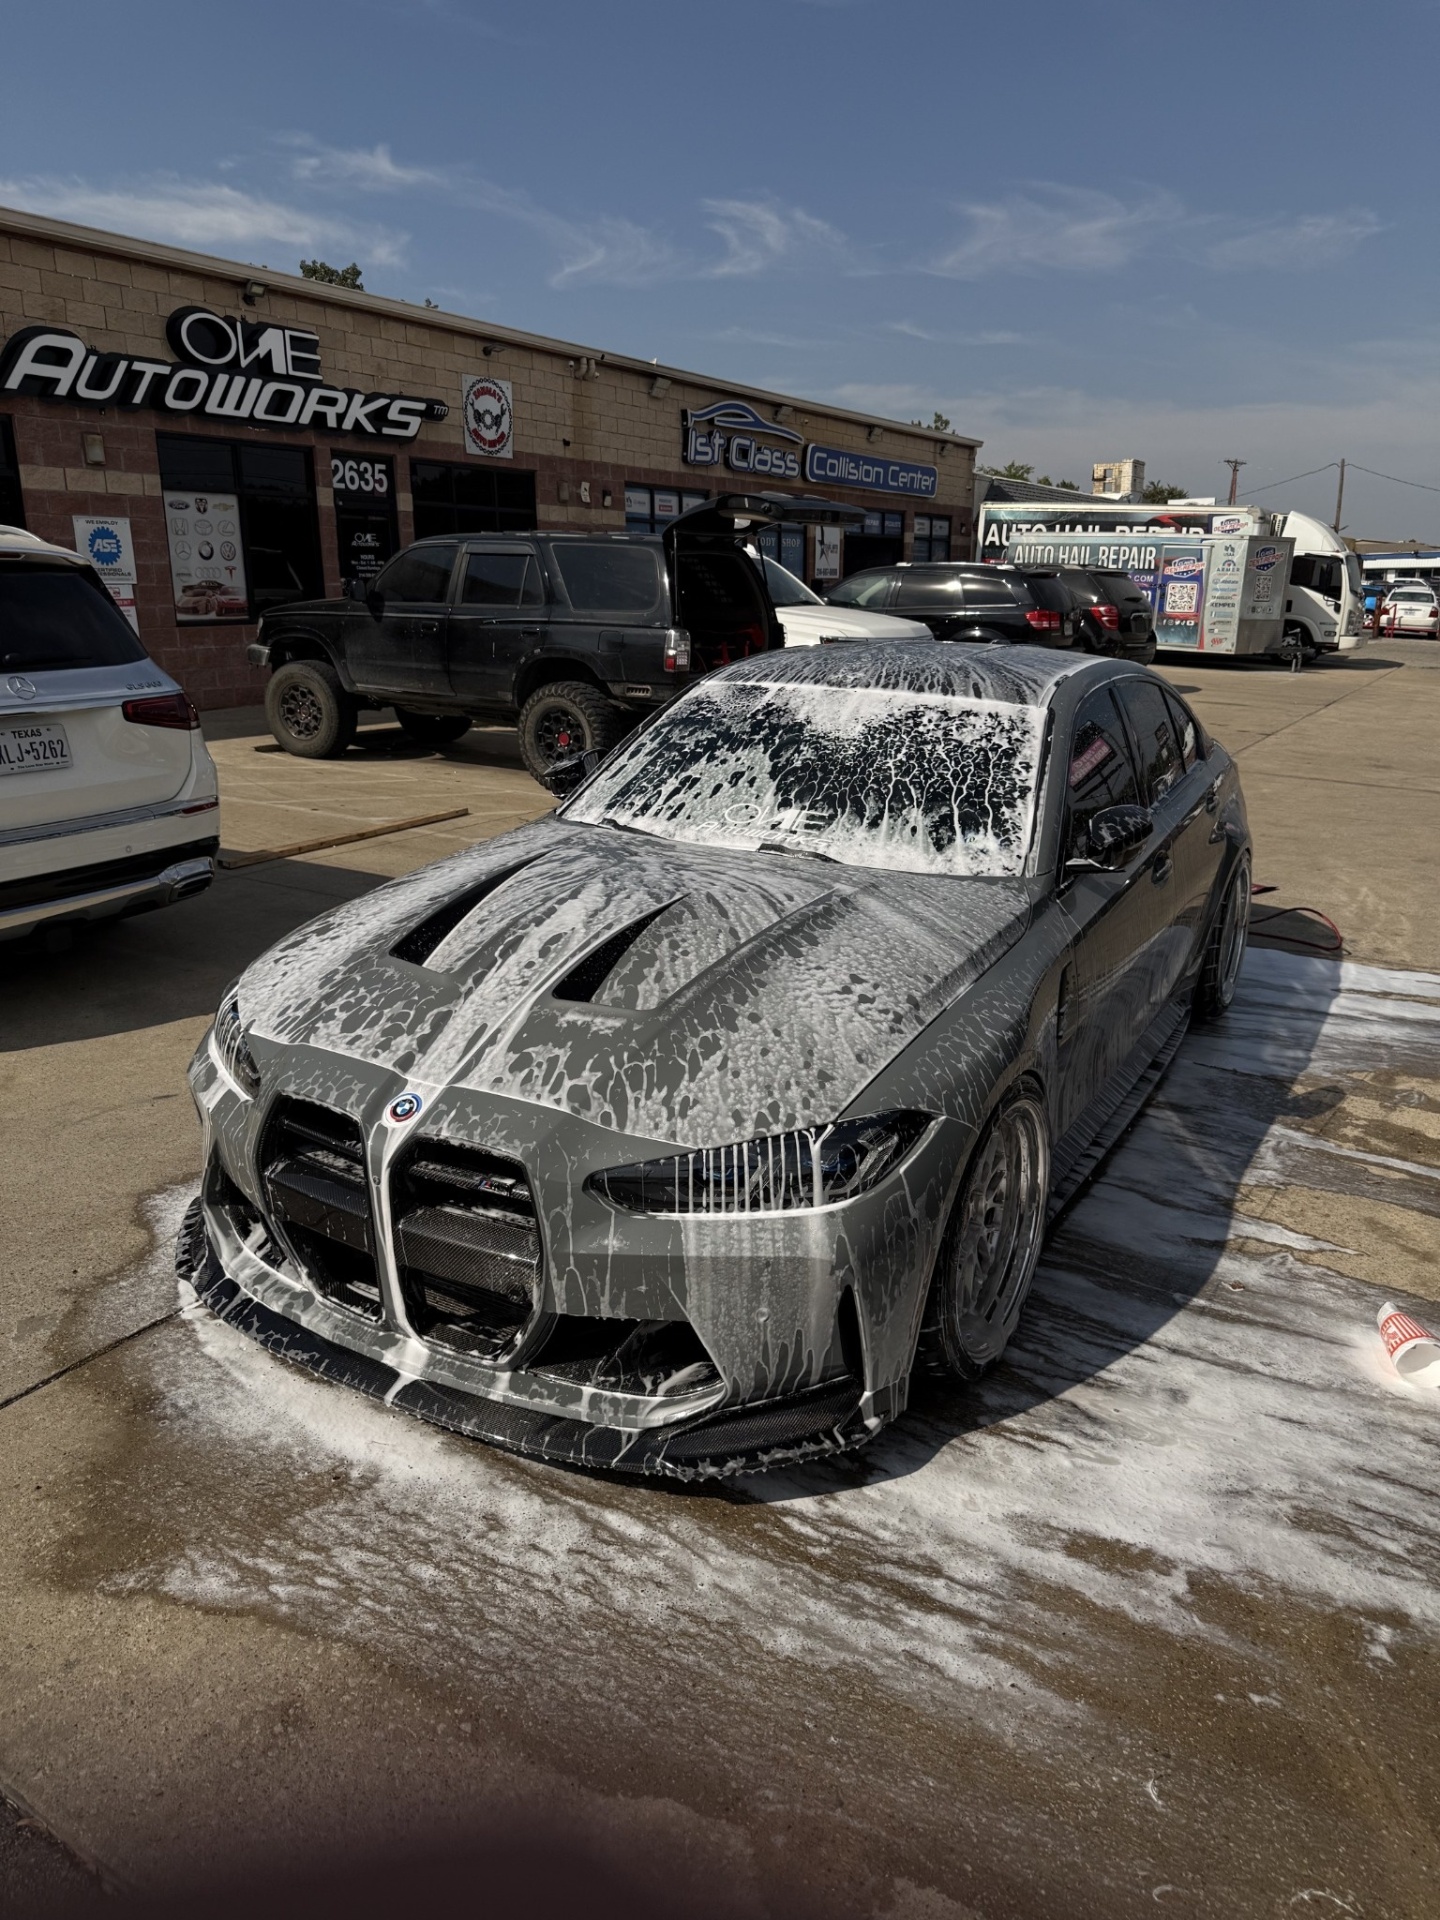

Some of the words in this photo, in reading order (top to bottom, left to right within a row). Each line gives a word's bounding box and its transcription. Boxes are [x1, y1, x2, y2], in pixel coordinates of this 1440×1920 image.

[181, 312, 323, 381] ONE
[731, 437, 800, 477] Class
[331, 458, 389, 493] 2635
[813, 451, 884, 485] Collision
[888, 466, 935, 491] Center
[93, 538, 117, 553] ASE
[782, 538, 801, 547] SHOP
[1098, 546, 1156, 570] REPAIR
[11, 728, 42, 739] TEXAS
[29, 739, 68, 761] 5262
